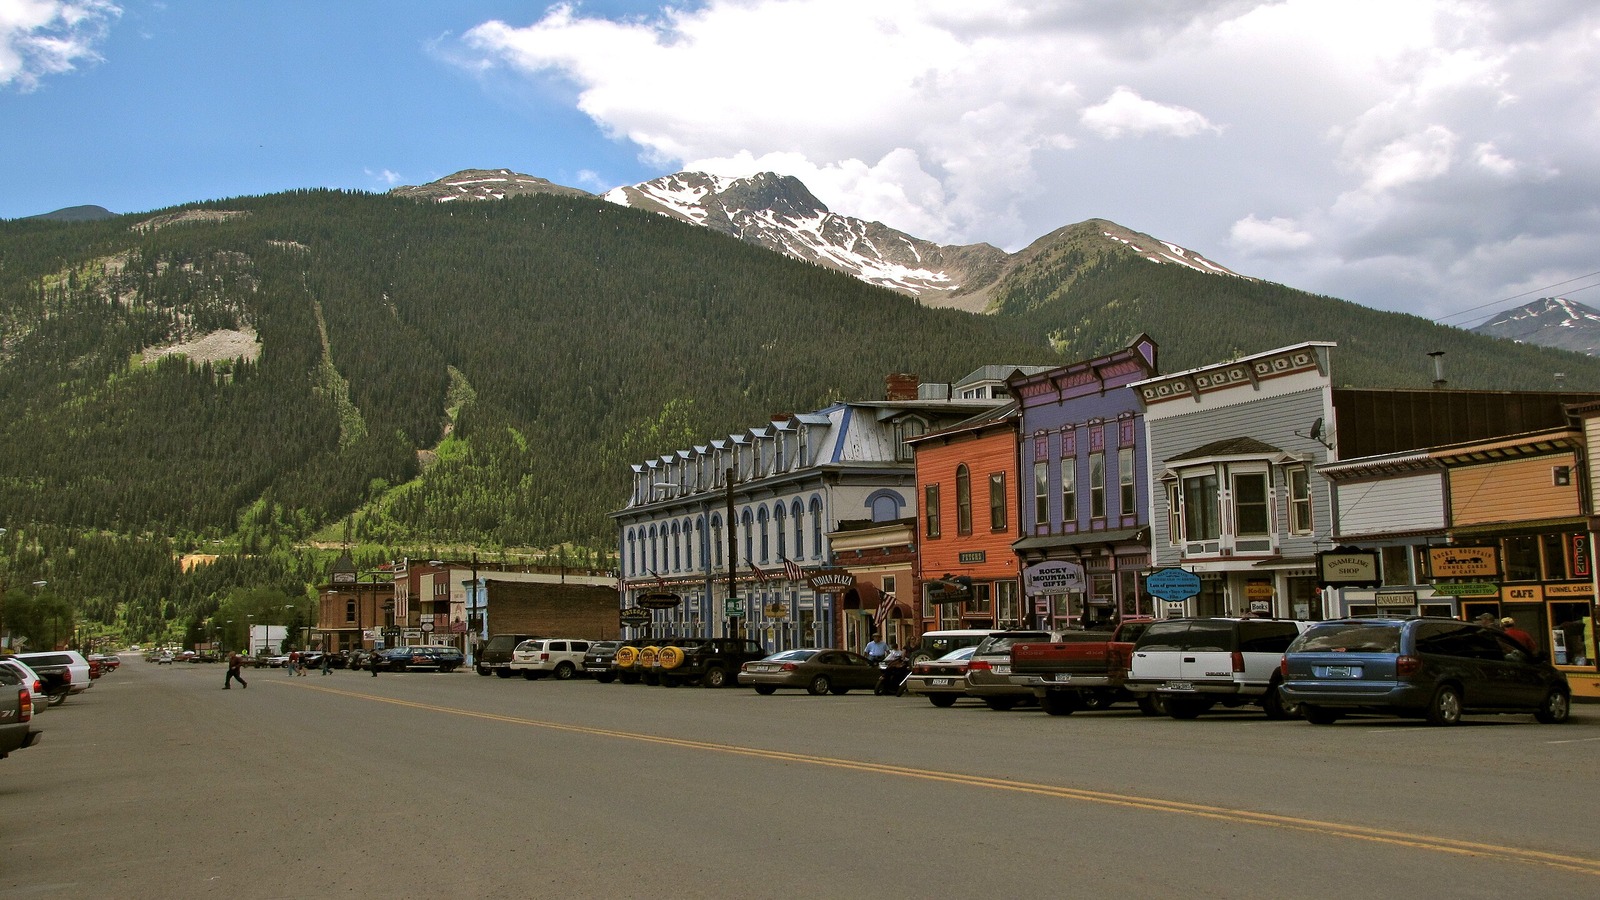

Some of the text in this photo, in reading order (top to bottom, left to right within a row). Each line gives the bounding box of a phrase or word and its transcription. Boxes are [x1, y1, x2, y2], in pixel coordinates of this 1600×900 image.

[1433, 549, 1492, 560] ROCKY MOUNTAIN
[1575, 538, 1585, 573] OPEN
[1328, 558, 1369, 569] ENAMELING
[811, 574, 853, 587] INDIAN PLAZA
[1032, 573, 1075, 581] MOUNTAIN
[1510, 589, 1534, 598] CAFE
[1377, 595, 1414, 604] ENAMELING
